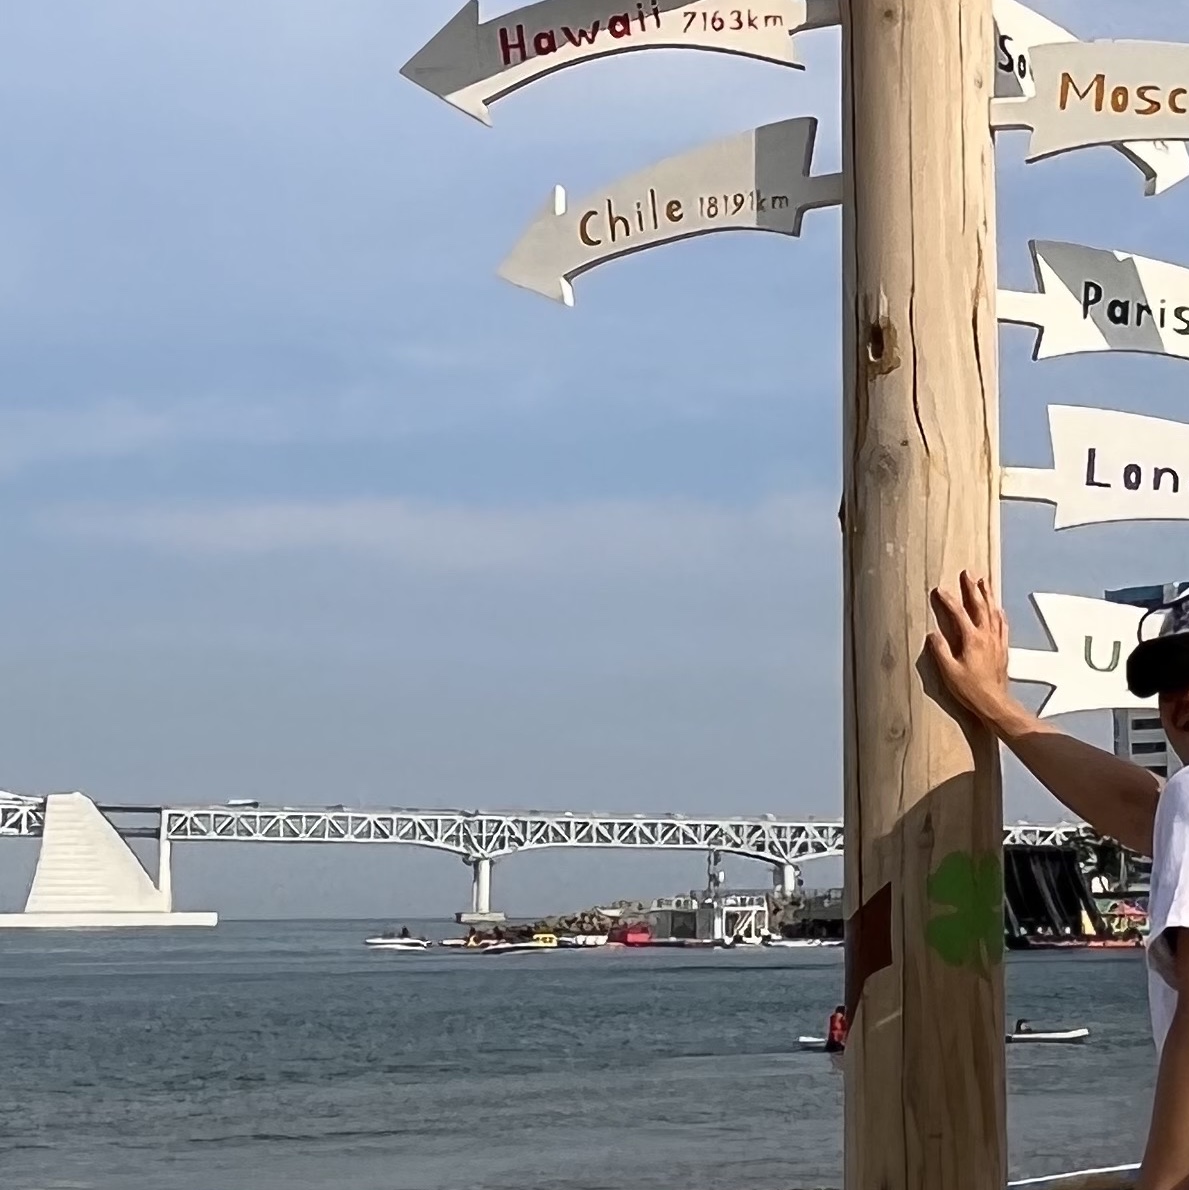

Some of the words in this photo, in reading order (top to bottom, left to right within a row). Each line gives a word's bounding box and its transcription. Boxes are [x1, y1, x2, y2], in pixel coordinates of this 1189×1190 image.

[499, 0, 661, 65] Hawaii
[682, 10, 784, 33] 7163km
[998, 34, 1035, 79] So
[579, 189, 684, 247] Chile
